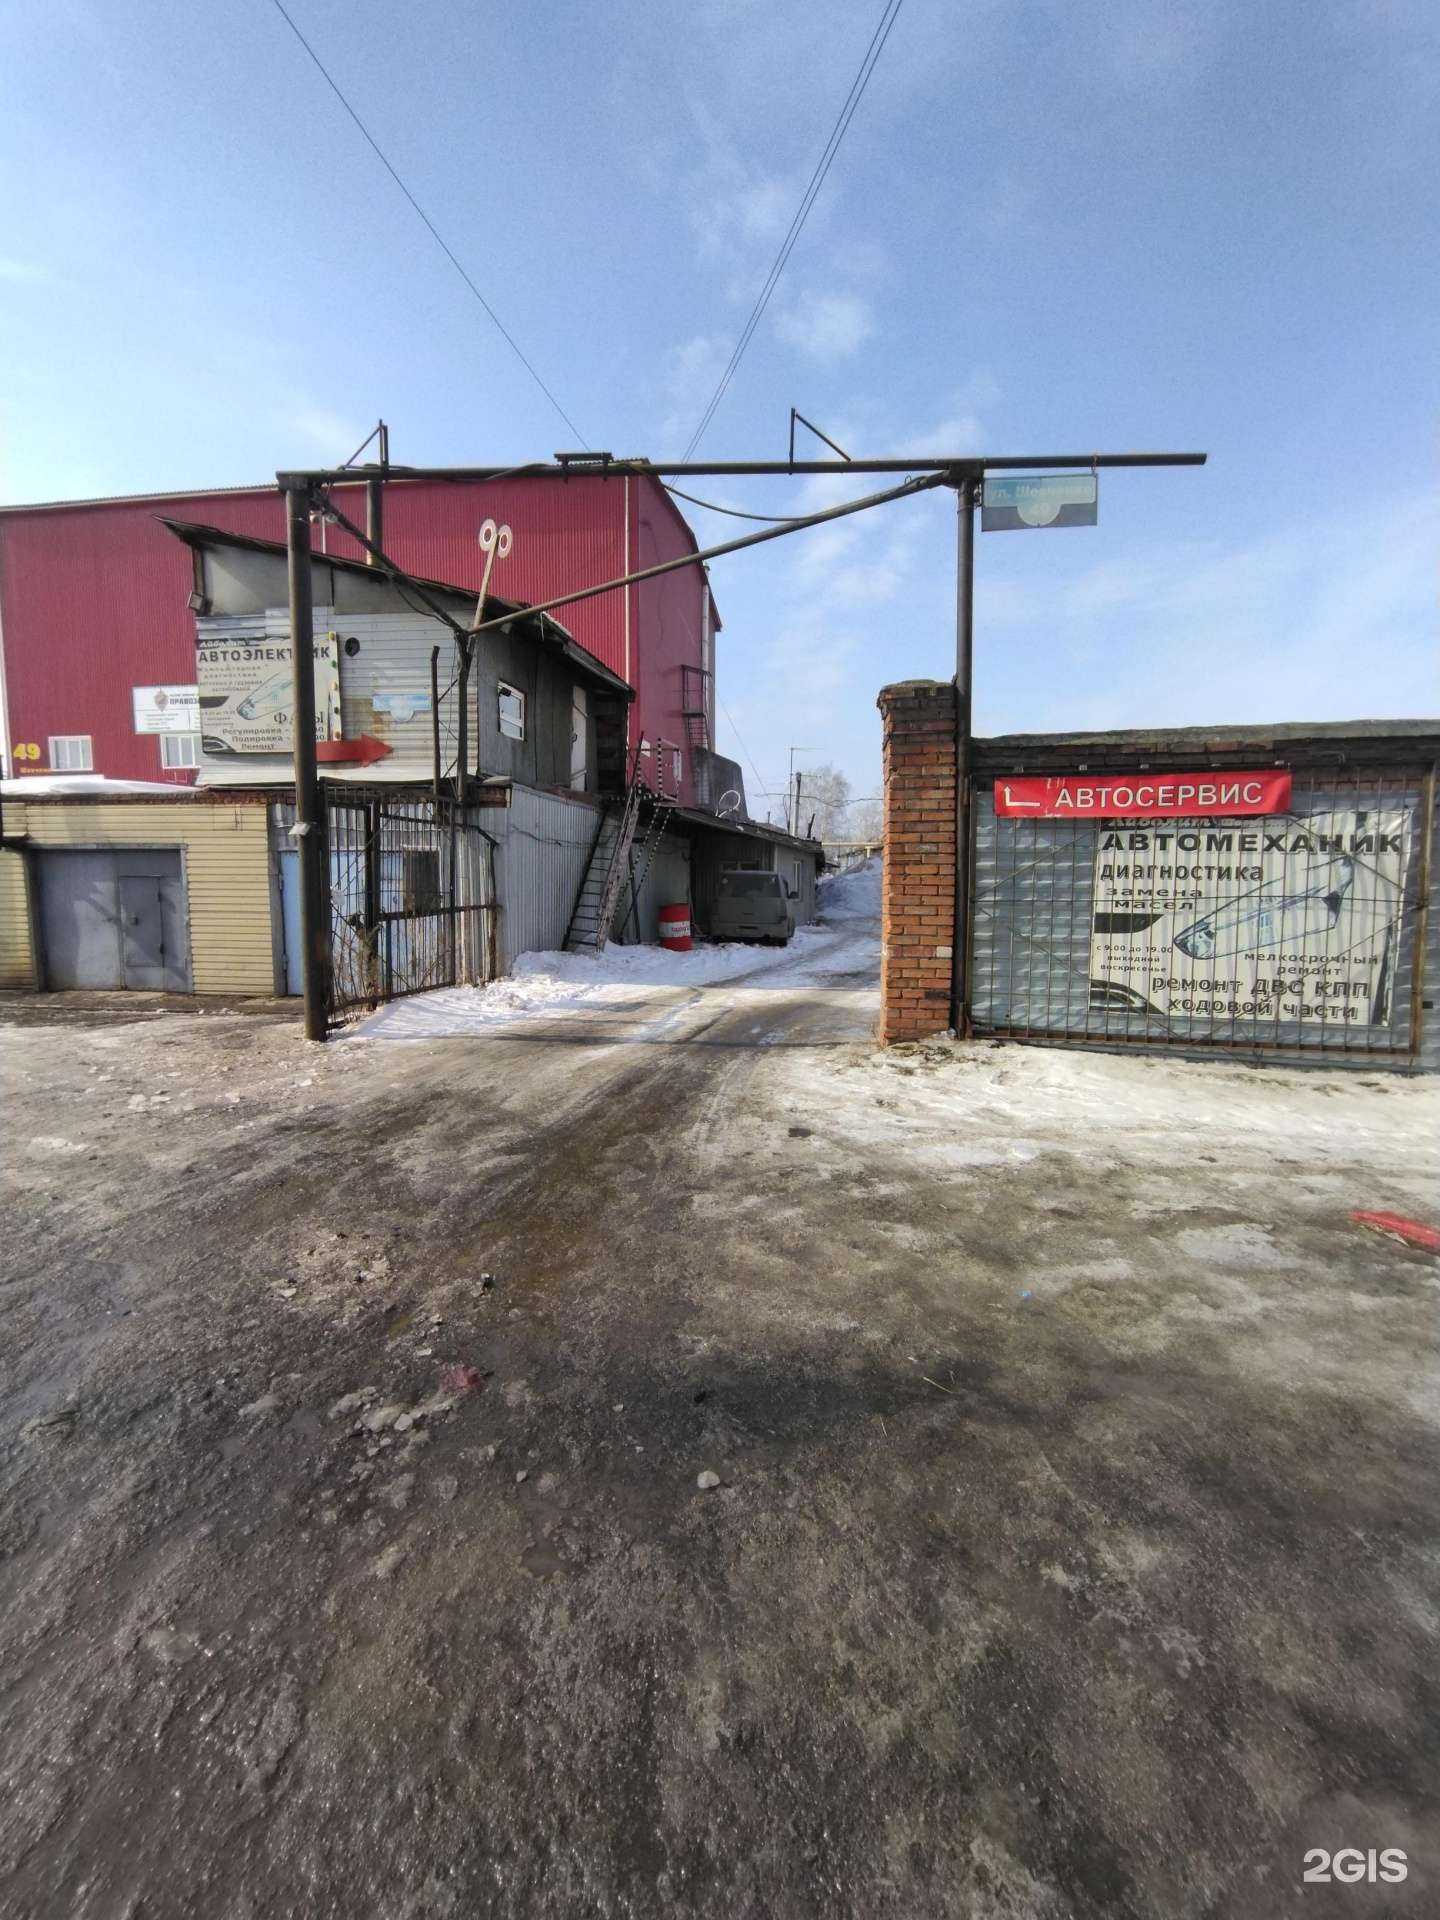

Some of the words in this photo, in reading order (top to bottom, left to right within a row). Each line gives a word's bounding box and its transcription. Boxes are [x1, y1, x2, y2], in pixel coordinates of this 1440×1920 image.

[199, 646, 330, 662] АВТОЭЛЕКТИК
[13, 743, 40, 760] 49
[1055, 782, 1263, 808] АВТОСЕРВИС
[1102, 832, 1403, 855] АВТОМЕХАНИК
[1099, 863, 1264, 882] диагностика
[1106, 887, 1203, 898] замена
[1114, 899, 1194, 911] масел
[1129, 945, 1142, 953] до
[1151, 977, 1243, 993] ремонт
[1250, 978, 1306, 997] ДВС
[1315, 981, 1368, 999] КПП
[1167, 998, 1273, 1016] ходовой
[1283, 1003, 1358, 1020] части
